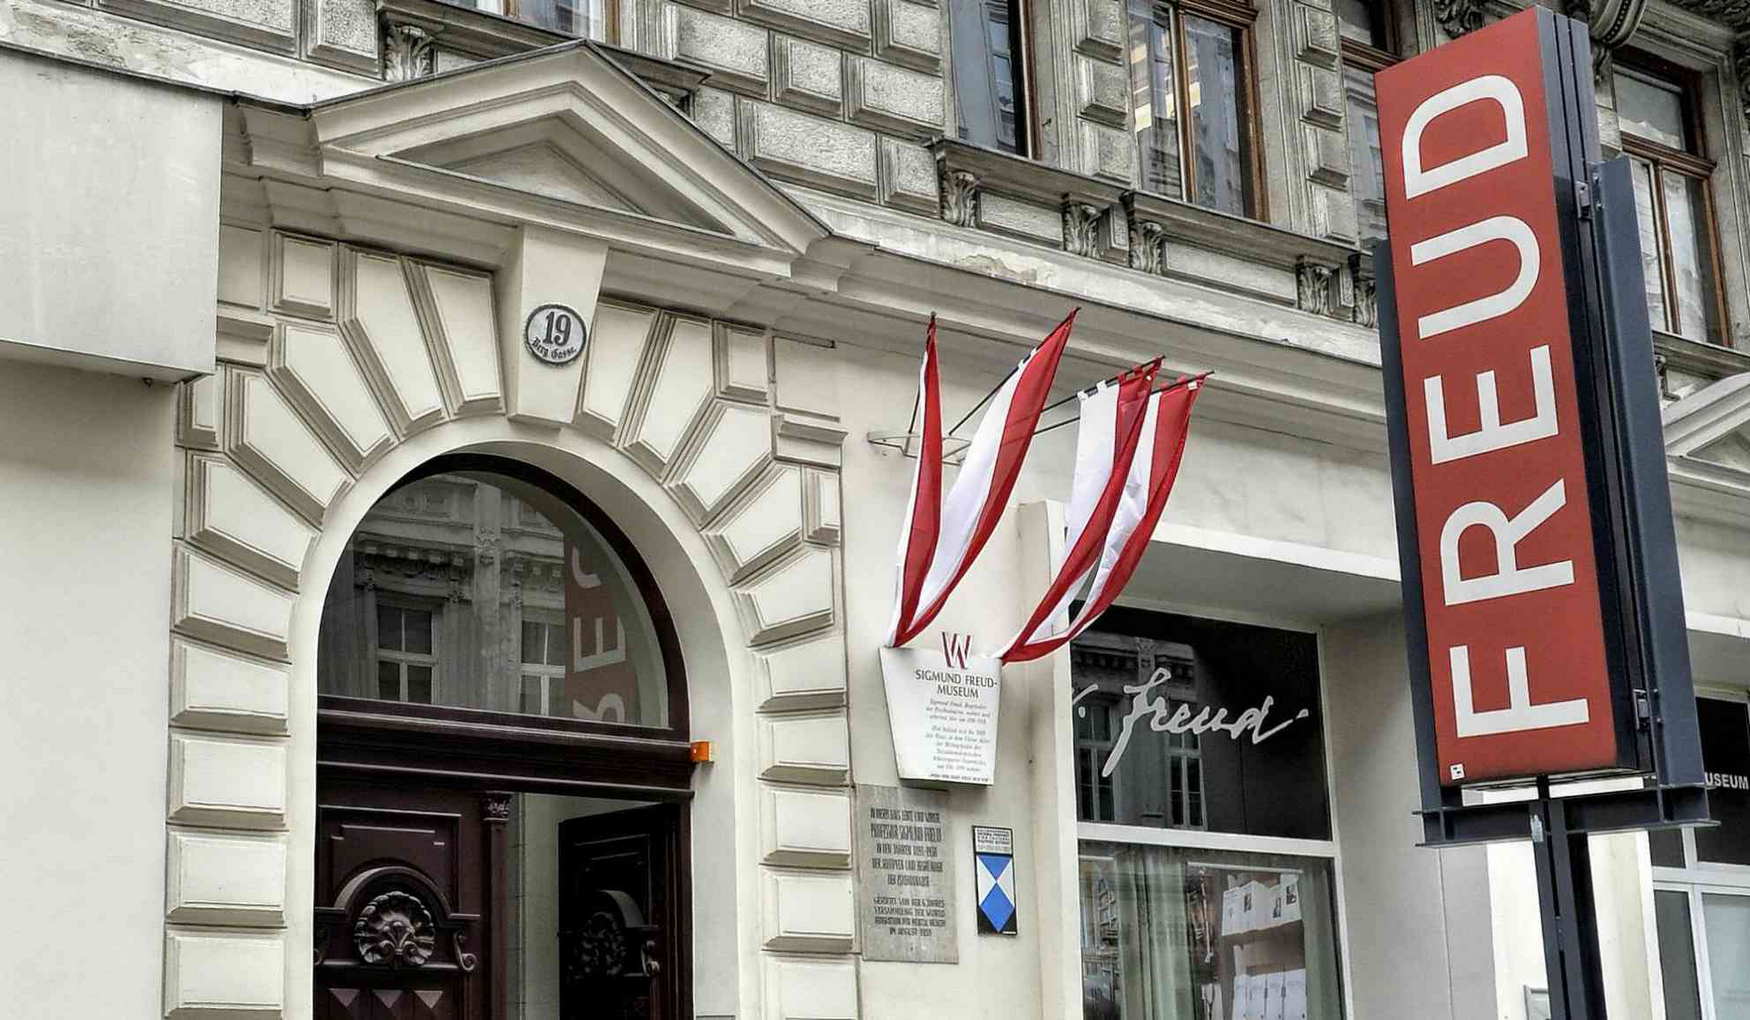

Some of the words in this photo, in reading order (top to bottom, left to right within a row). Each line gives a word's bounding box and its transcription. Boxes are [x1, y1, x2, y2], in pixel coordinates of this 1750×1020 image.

[542, 311, 572, 346] 19
[1401, 74, 1590, 738] FREUD
[915, 669, 961, 684] SIGMUND
[965, 675, 998, 688] FREUD-
[937, 684, 979, 698] MUSEUM
[1704, 771, 1749, 790] USEUM
